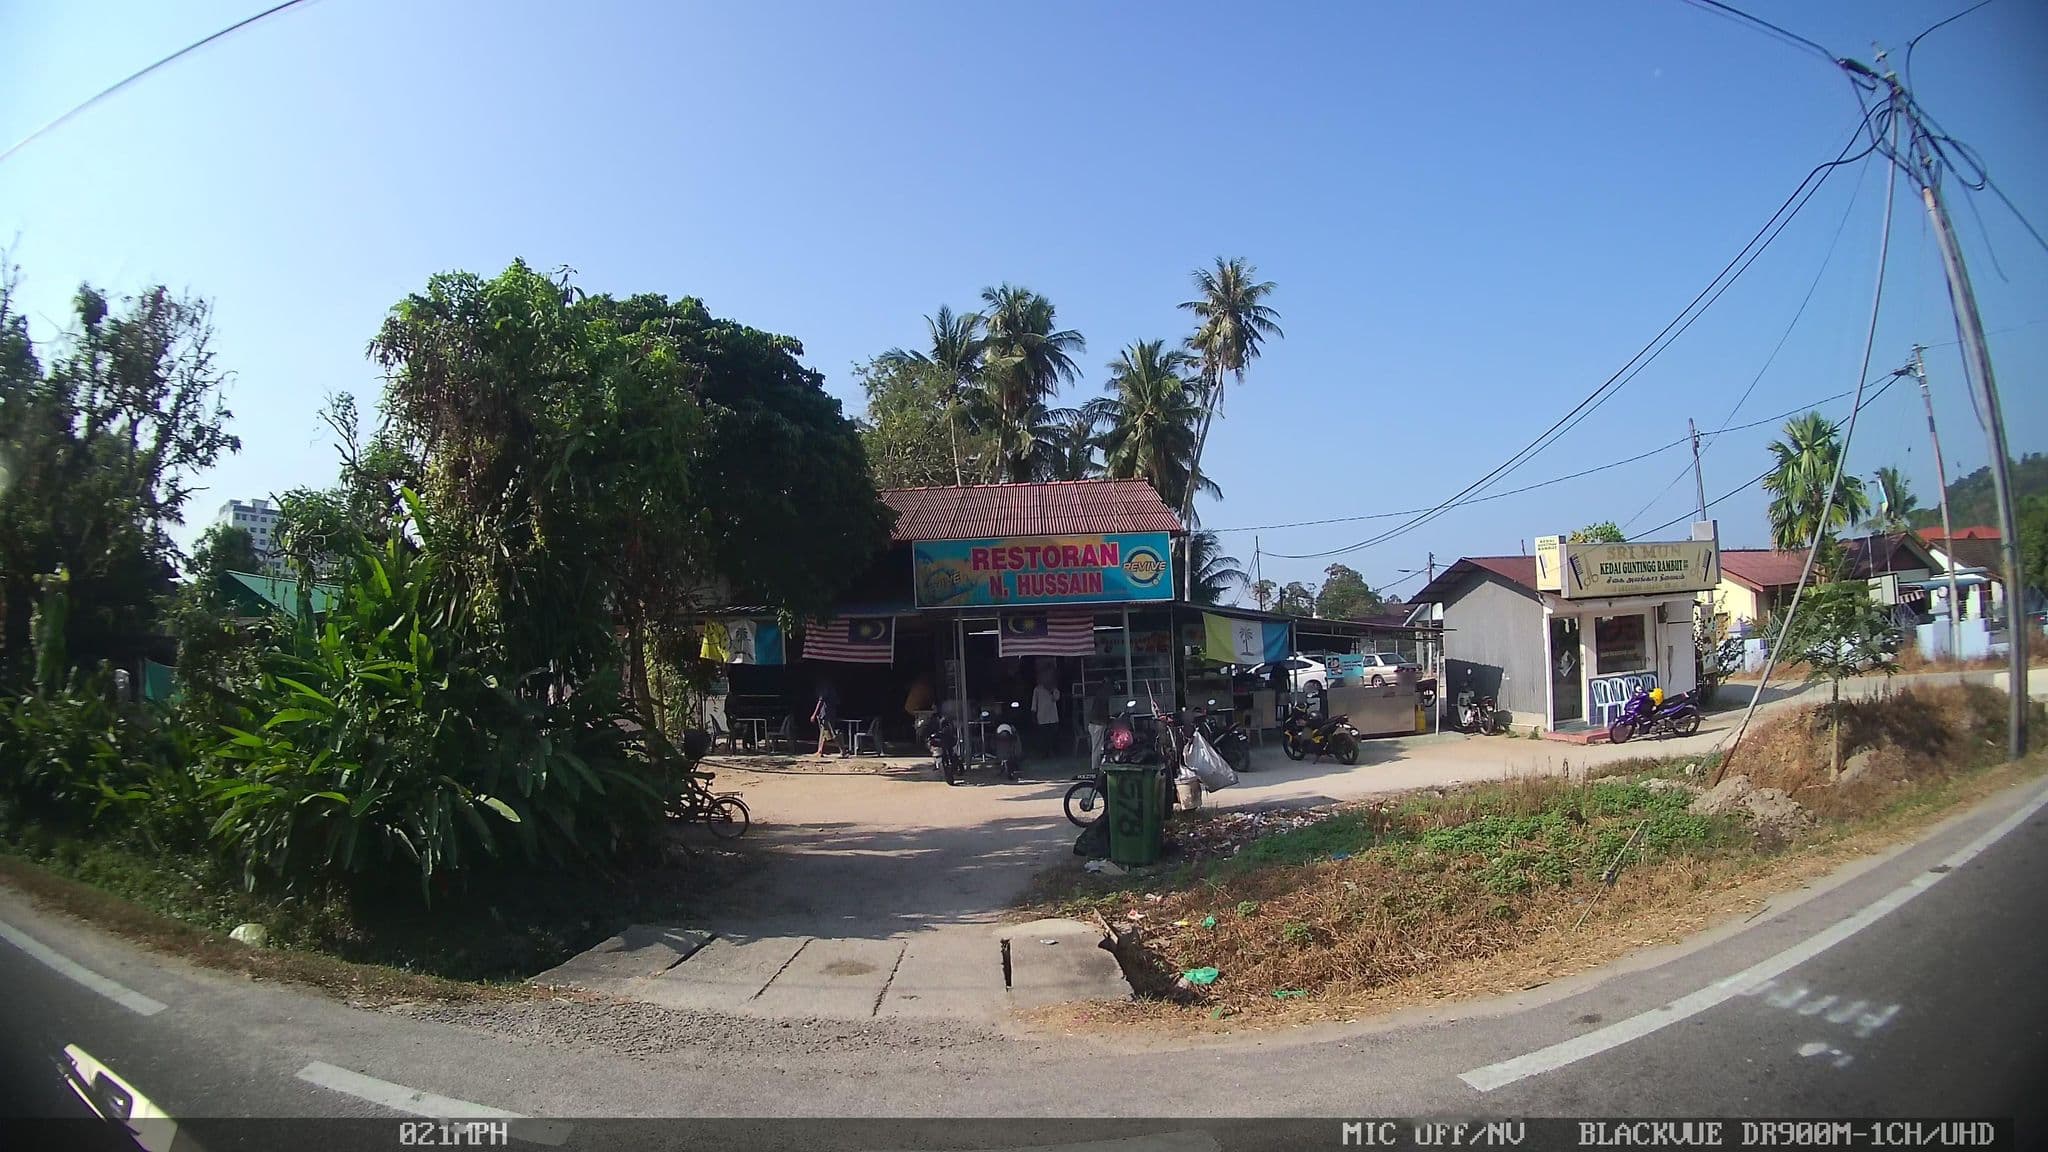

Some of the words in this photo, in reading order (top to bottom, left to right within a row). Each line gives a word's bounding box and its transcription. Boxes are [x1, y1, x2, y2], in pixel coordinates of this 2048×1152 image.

[971, 542, 1119, 571] RESTORAN
[1606, 546, 1636, 560] SRI
[1122, 560, 1168, 572] REVIVE
[1600, 562, 1622, 576] KEDAI
[1622, 561, 1657, 574] GUNTINGG
[1657, 559, 1683, 572] RAMBUT
[989, 576, 1009, 597] N.
[1017, 572, 1105, 597] HUSSAIN
